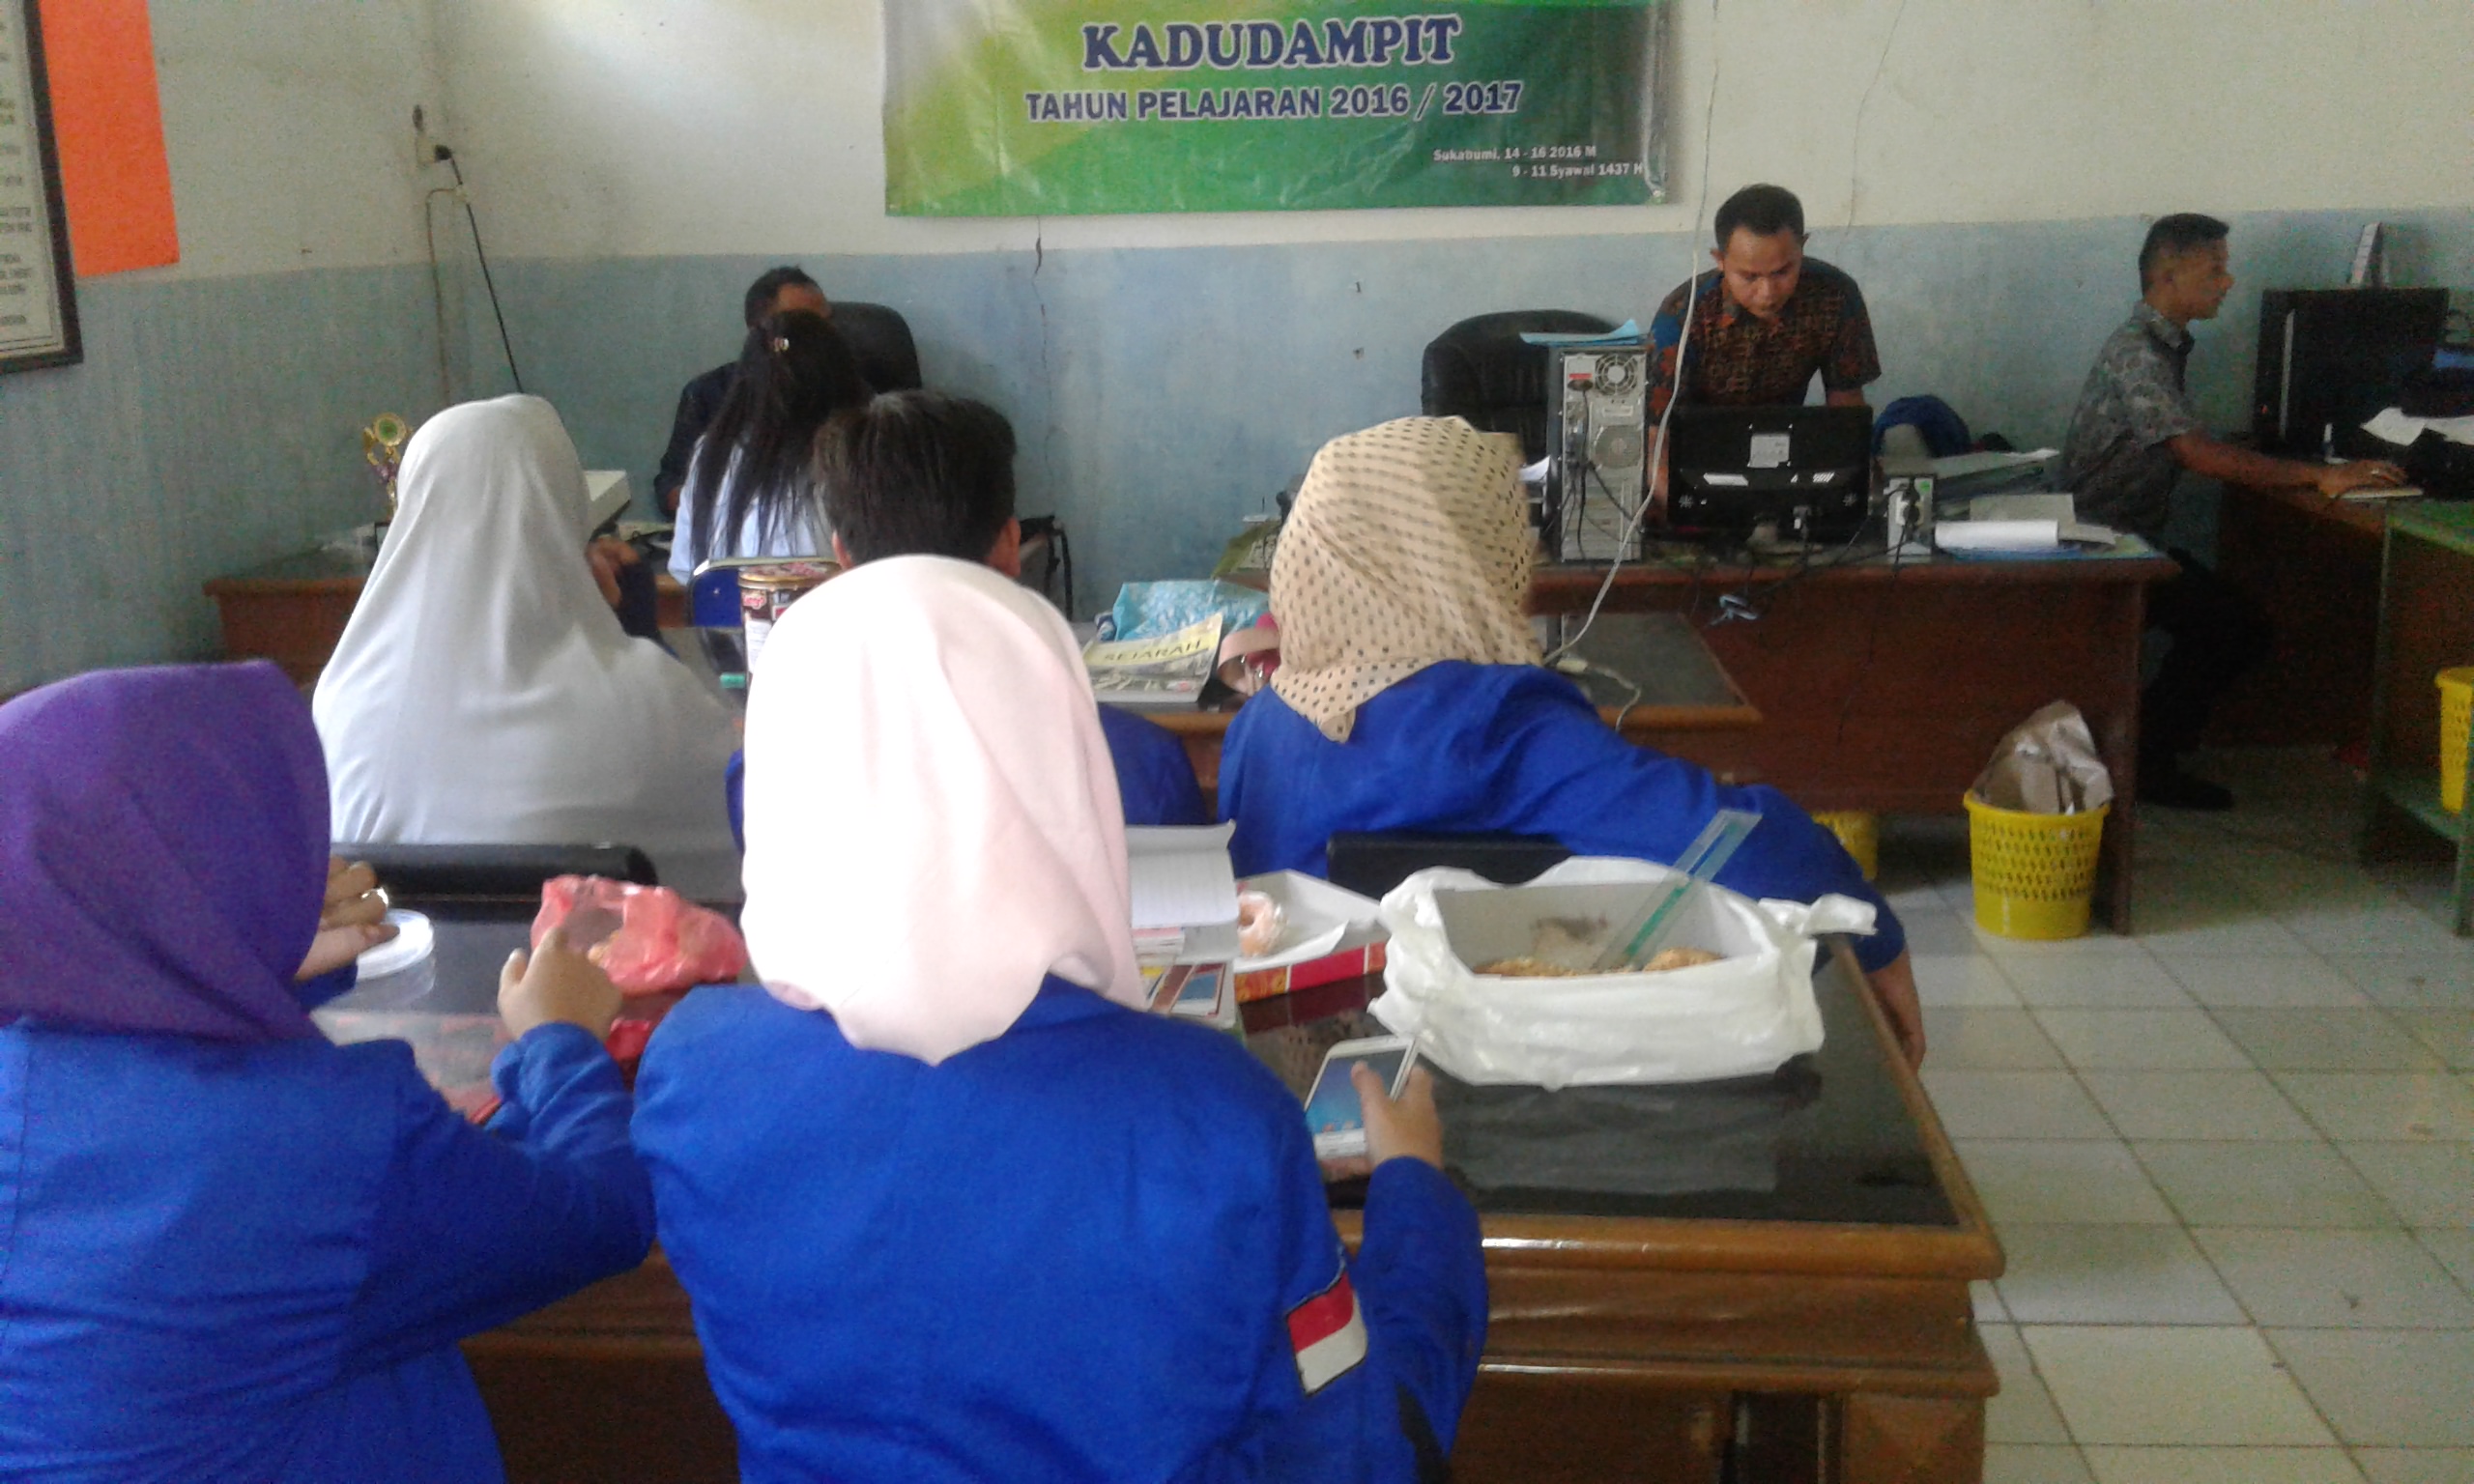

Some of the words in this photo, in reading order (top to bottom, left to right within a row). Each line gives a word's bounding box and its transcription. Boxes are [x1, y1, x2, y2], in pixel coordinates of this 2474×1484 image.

[1082, 15, 1460, 70] KADUDAMPIT
[1025, 92, 1128, 121] TAHUN
[1136, 89, 1321, 119] PELAJARAN
[1330, 85, 1410, 116] 2016
[1414, 83, 1437, 121] /
[1444, 80, 1522, 114] 2017
[1505, 147, 1520, 159] 14
[1549, 146, 1582, 158] 2016
[1585, 146, 1597, 157] M
[1512, 165, 1520, 178] 9
[1532, 165, 1546, 178] 11
[1550, 164, 1595, 179] Syawal
[1598, 163, 1629, 175] 1437
[1633, 162, 1643, 175] H
